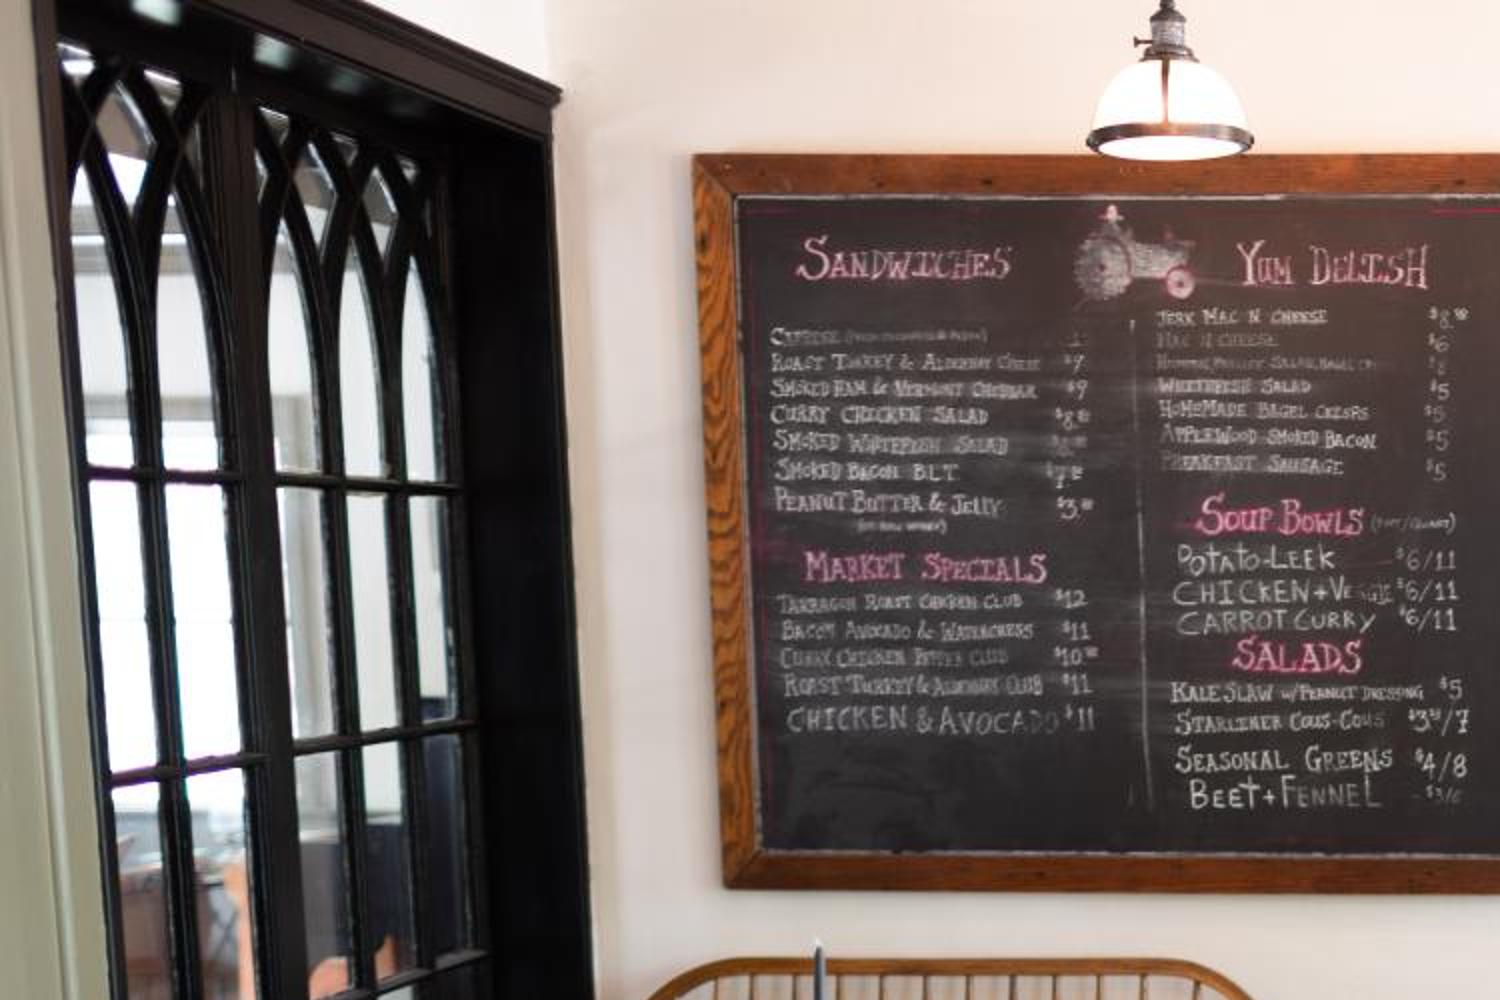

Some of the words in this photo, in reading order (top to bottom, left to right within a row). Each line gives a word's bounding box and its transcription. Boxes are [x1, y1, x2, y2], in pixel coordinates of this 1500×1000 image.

[796, 235, 1011, 281] SANDWICHES
[1236, 240, 1294, 287] YUM
[1309, 245, 1430, 289] DELISH
[771, 353, 824, 371] ROAST
[832, 353, 893, 371] TURKEY
[770, 380, 828, 397] SMOKED
[895, 380, 962, 399] VERMONT
[1261, 378, 1310, 393] SALAD
[770, 406, 830, 424] CURRY
[841, 406, 921, 424] CHICKEN
[934, 406, 988, 425] SALAD
[1160, 401, 1246, 418] HOMEMADE
[1257, 402, 1307, 418] BAGEL
[773, 430, 840, 451] SMOKED
[848, 436, 940, 454] WHITEFISH
[956, 436, 1008, 455] SALAD
[1267, 429, 1317, 444] SMOKED
[1326, 431, 1376, 449] BACON
[775, 459, 841, 481] SMOKED
[848, 464, 897, 481] BACON
[1161, 452, 1257, 471] BREAKFAST
[1268, 455, 1344, 474] SAUSAGE
[774, 487, 846, 512] PEANUT
[851, 490, 925, 514] BUTTER
[929, 493, 946, 512] &
[951, 496, 1002, 516] JELLY
[1196, 495, 1272, 535] SOUP
[1280, 498, 1364, 535] BOWLS
[802, 551, 905, 584] MARKET
[921, 553, 1048, 584] SPECIALS
[865, 596, 912, 609] ROAST
[984, 594, 1023, 608] CLUB
[1056, 589, 1087, 608] $12
[846, 622, 910, 639] AVOCADO
[918, 622, 934, 638] &
[1064, 622, 1091, 640] $11
[1177, 611, 1287, 635] CARROT
[1295, 611, 1376, 634] CURRY
[1232, 635, 1362, 672] SALADS
[785, 674, 842, 696] ROAST
[846, 674, 912, 695] TURKEY
[916, 676, 929, 693] &
[1005, 674, 1043, 695] CLUB
[1062, 674, 1092, 695] $11
[1170, 682, 1220, 703] KALE
[1224, 683, 1273, 703] SLAW
[1361, 686, 1424, 701] DRESSING
[1441, 678, 1462, 700] $5
[787, 706, 908, 732] CHICKEN
[917, 709, 933, 732] &
[939, 707, 1059, 735] AVOCADO
[1065, 705, 1094, 731] $11
[1175, 743, 1289, 774] SEASONAL
[1305, 745, 1392, 773] GREENS
